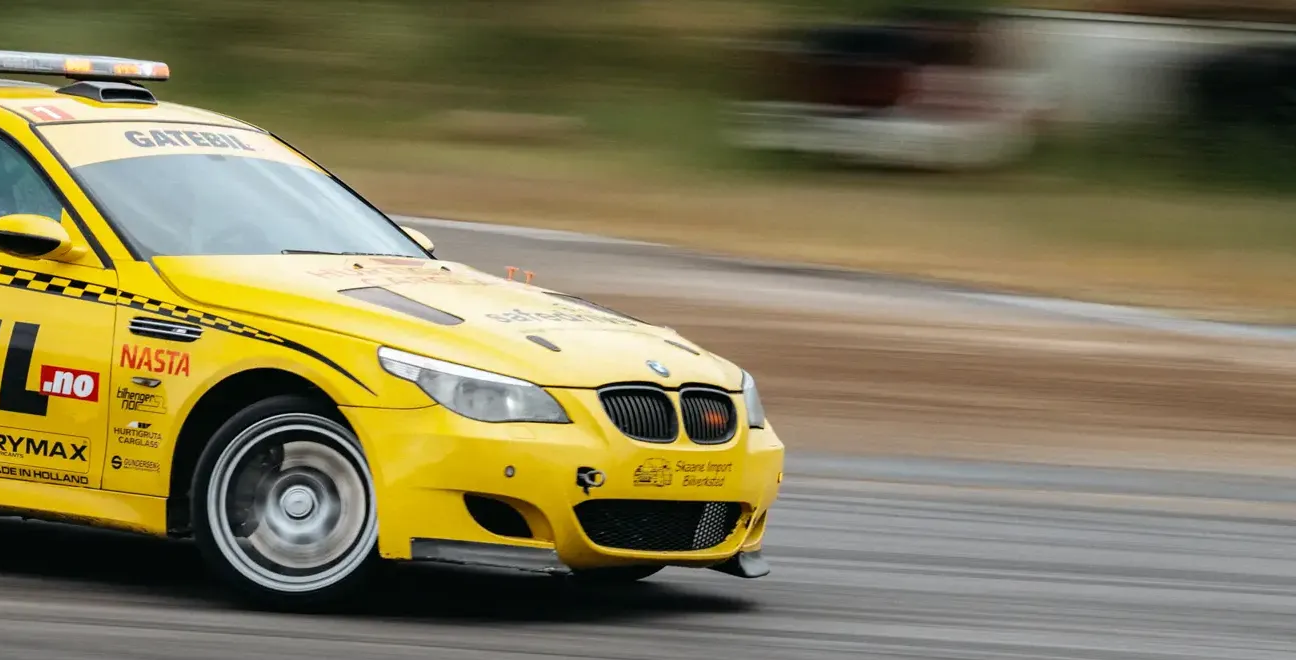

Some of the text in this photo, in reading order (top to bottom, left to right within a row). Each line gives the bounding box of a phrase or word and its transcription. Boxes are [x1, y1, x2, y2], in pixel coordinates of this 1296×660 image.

[33, 106, 62, 120] 1
[124, 130, 256, 151] GATEBIL
[120, 344, 190, 376] NASTA
[114, 427, 163, 441] HURTIGRUTA
[118, 437, 159, 448] CARGLASS
[19, 468, 31, 477] IN
[33, 470, 88, 484] HOLLAND
